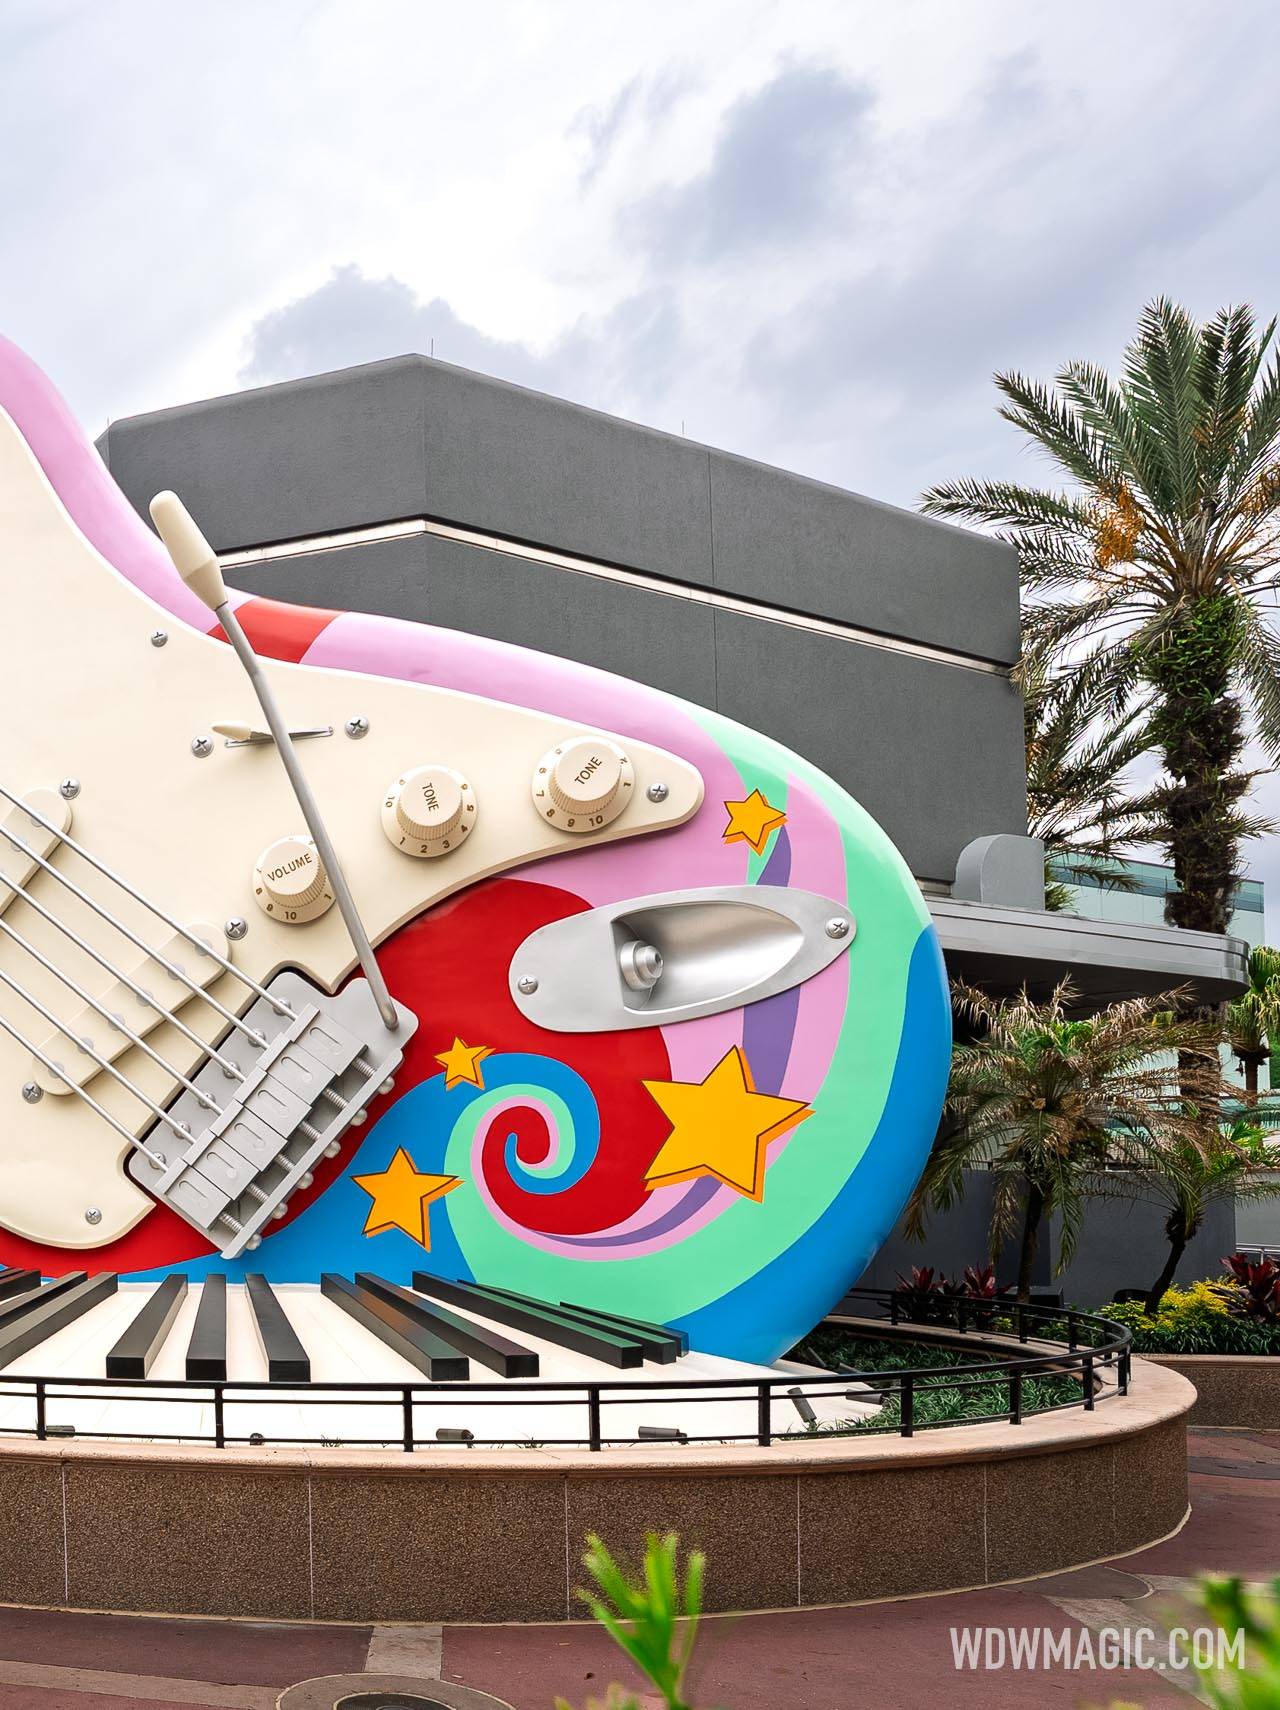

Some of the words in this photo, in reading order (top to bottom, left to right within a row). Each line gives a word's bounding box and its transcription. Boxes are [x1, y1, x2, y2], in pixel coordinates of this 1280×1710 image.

[574, 756, 602, 785] TONE
[422, 782, 439, 812] TONE
[400, 837, 406, 845] 1
[420, 844, 428, 853] 2
[442, 840, 450, 849] 3
[461, 825, 468, 833] 4
[466, 804, 474, 812] 5
[546, 808, 555, 817] 8
[567, 818, 575, 827] 9
[588, 815, 603, 826] 10
[267, 853, 313, 881] VOLUME
[284, 911, 297, 920] 10
